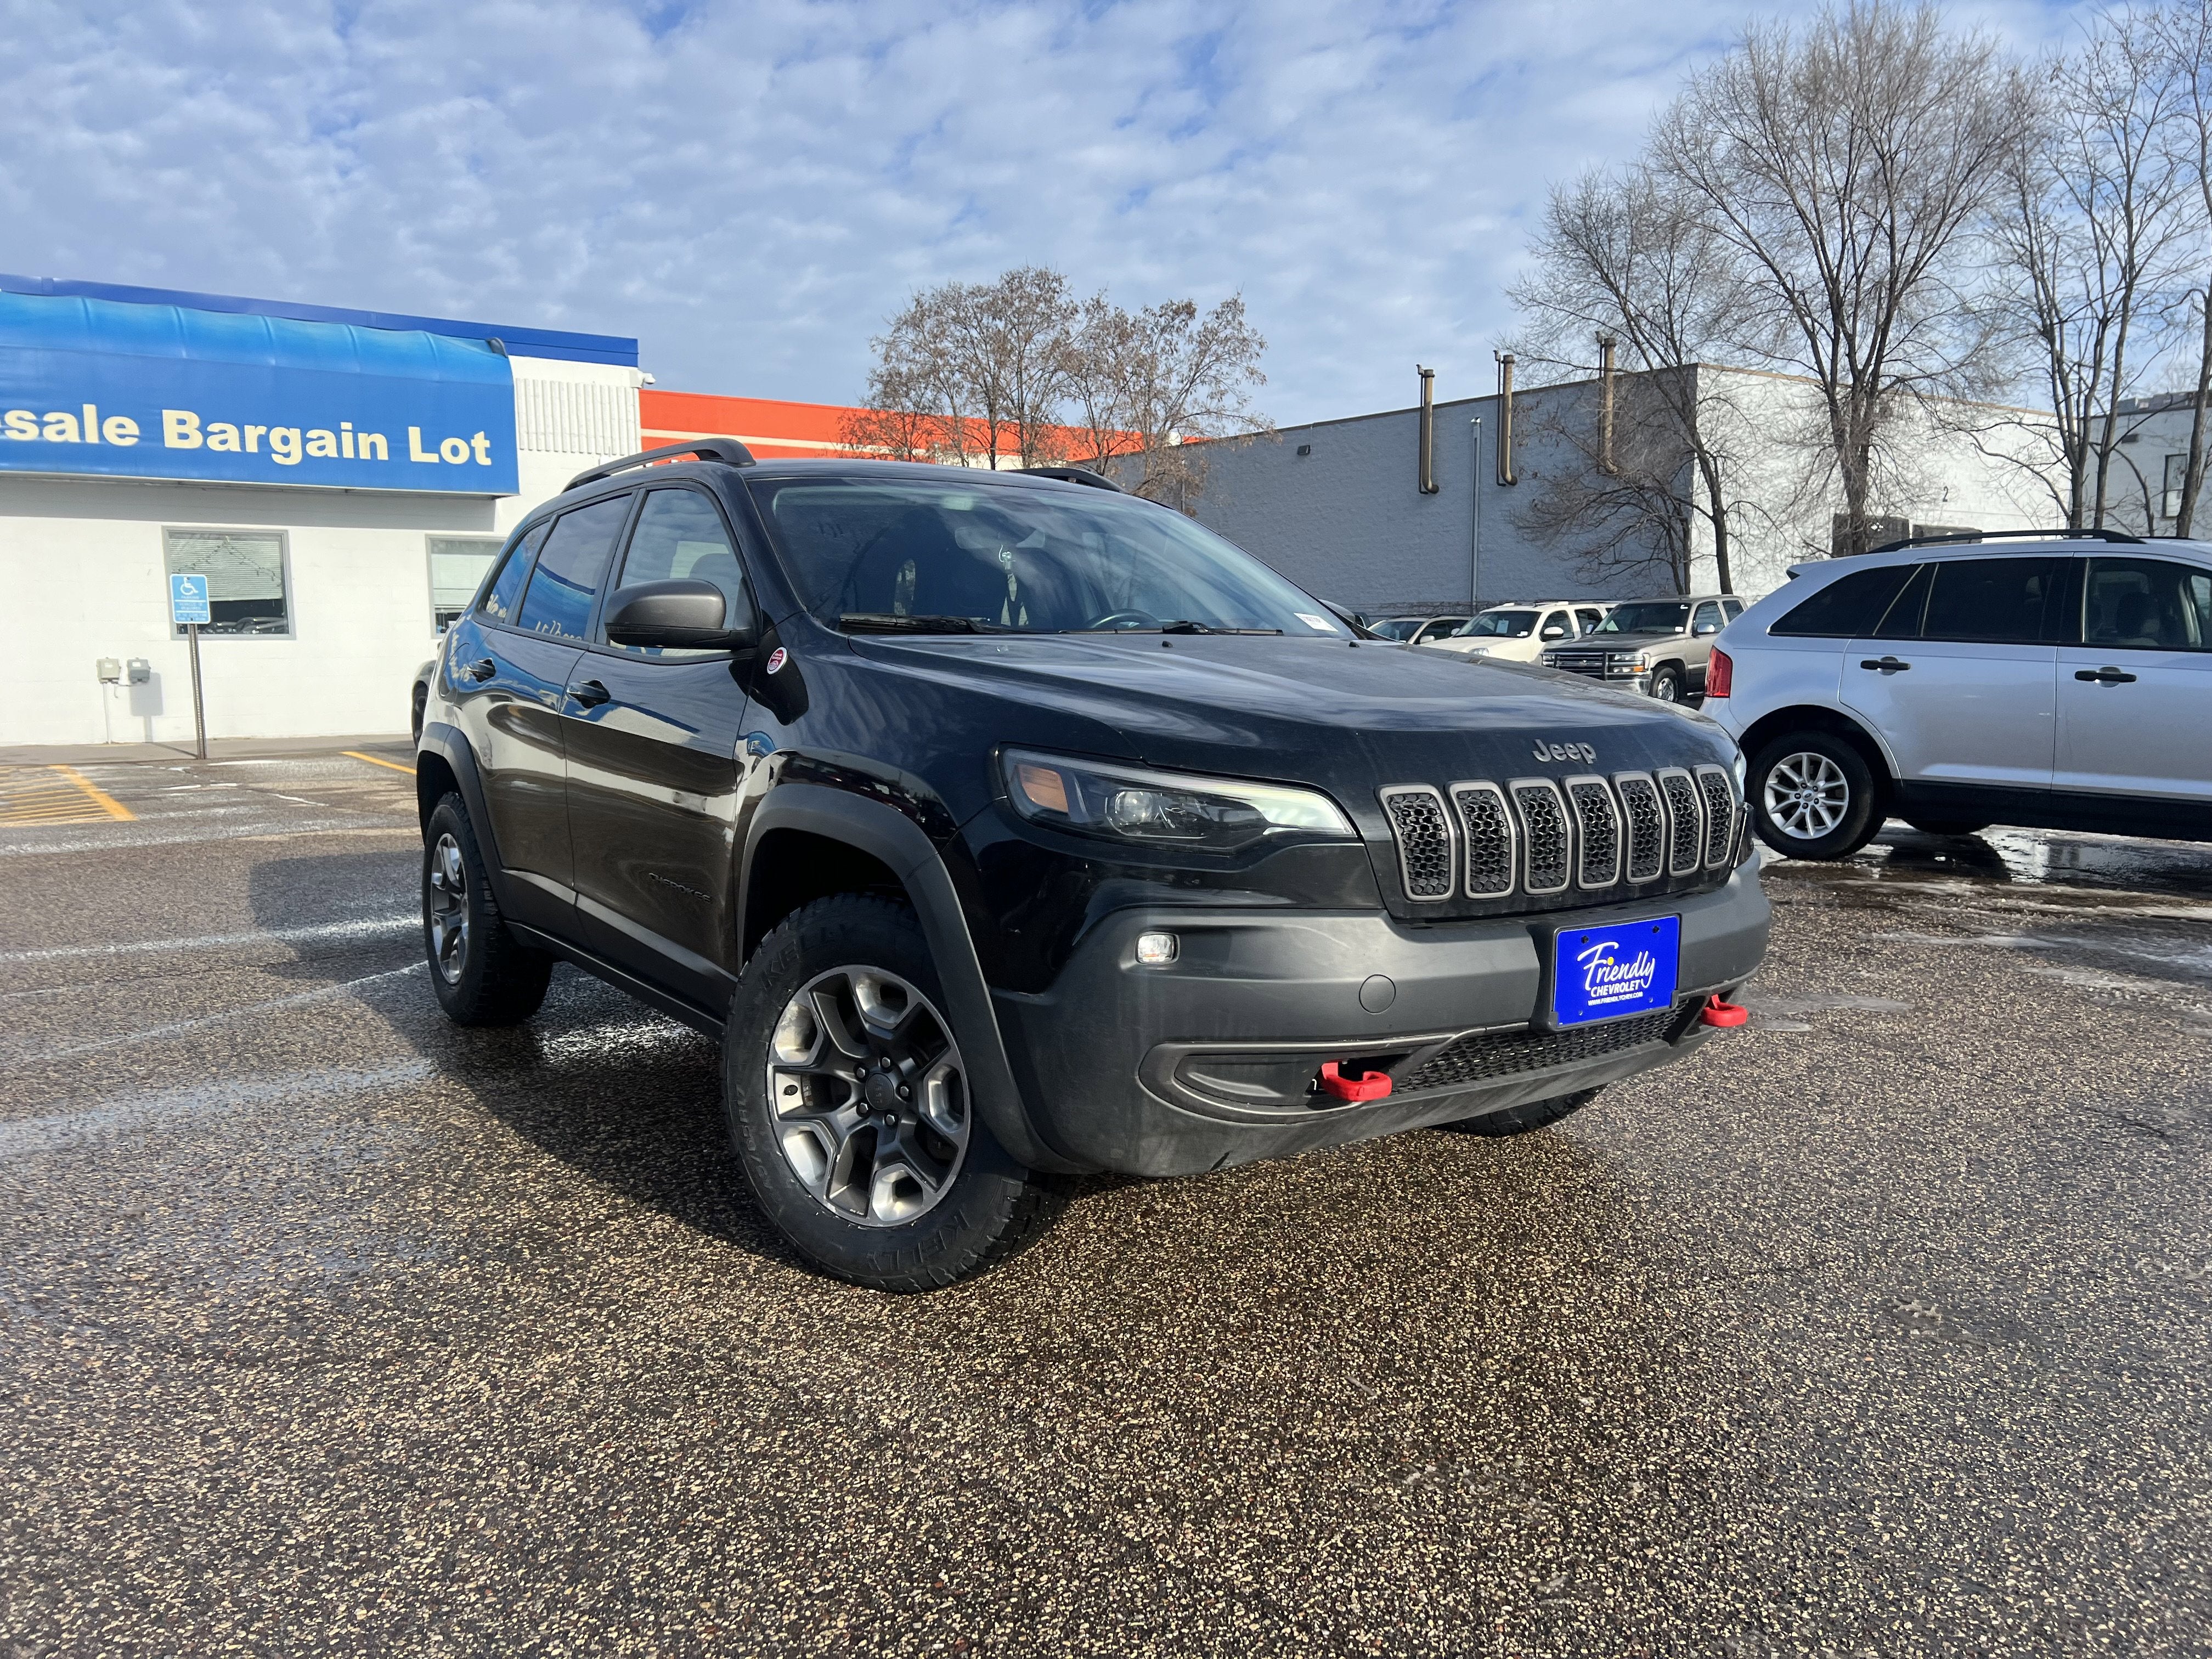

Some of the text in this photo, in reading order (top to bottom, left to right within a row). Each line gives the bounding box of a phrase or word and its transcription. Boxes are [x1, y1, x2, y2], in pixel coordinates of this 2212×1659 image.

[0, 403, 492, 466] sale Bargain Lot
[1532, 739, 1597, 764] Jeep
[1577, 941, 1655, 991] Friendly
[1588, 991, 1643, 1006] WWW.FRIENDLYCHEV.COM
[1590, 979, 1640, 997] CHEVROLET
